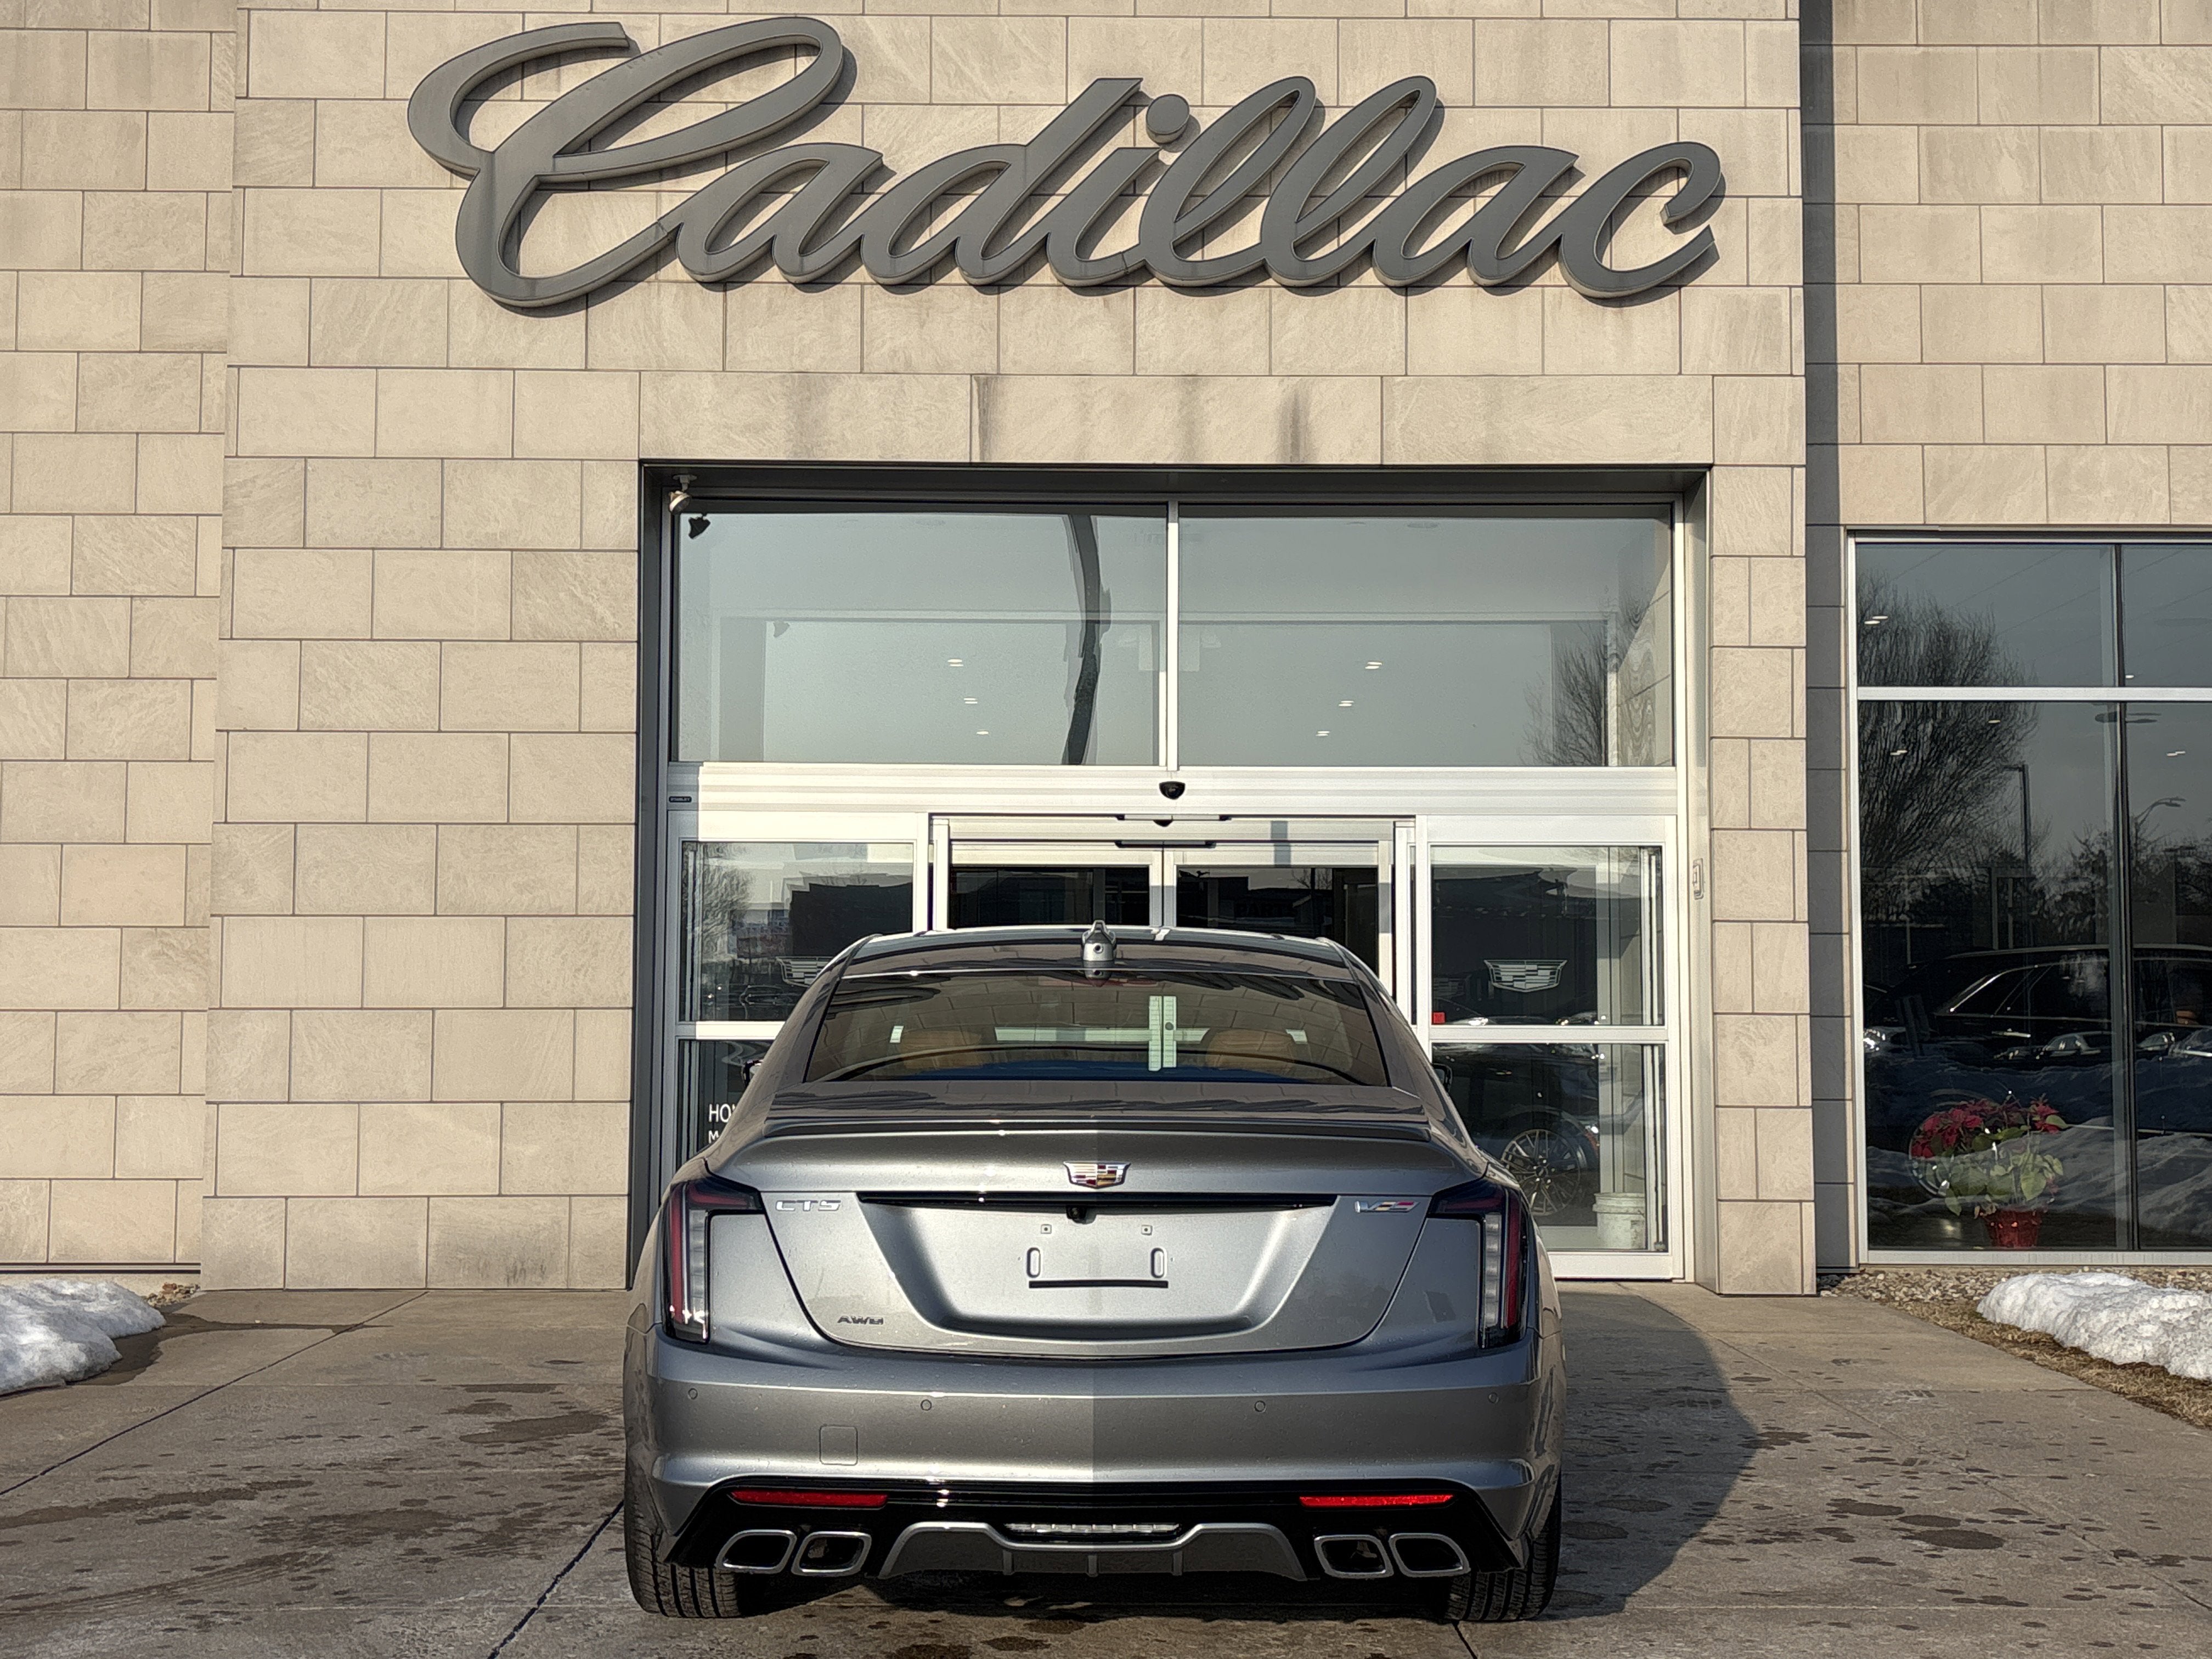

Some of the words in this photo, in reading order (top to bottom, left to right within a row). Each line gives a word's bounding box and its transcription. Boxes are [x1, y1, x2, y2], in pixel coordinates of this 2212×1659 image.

[407, 15, 1725, 309] Cadillac
[708, 1103, 736, 1123] HO
[837, 1316, 884, 1325] AWD
